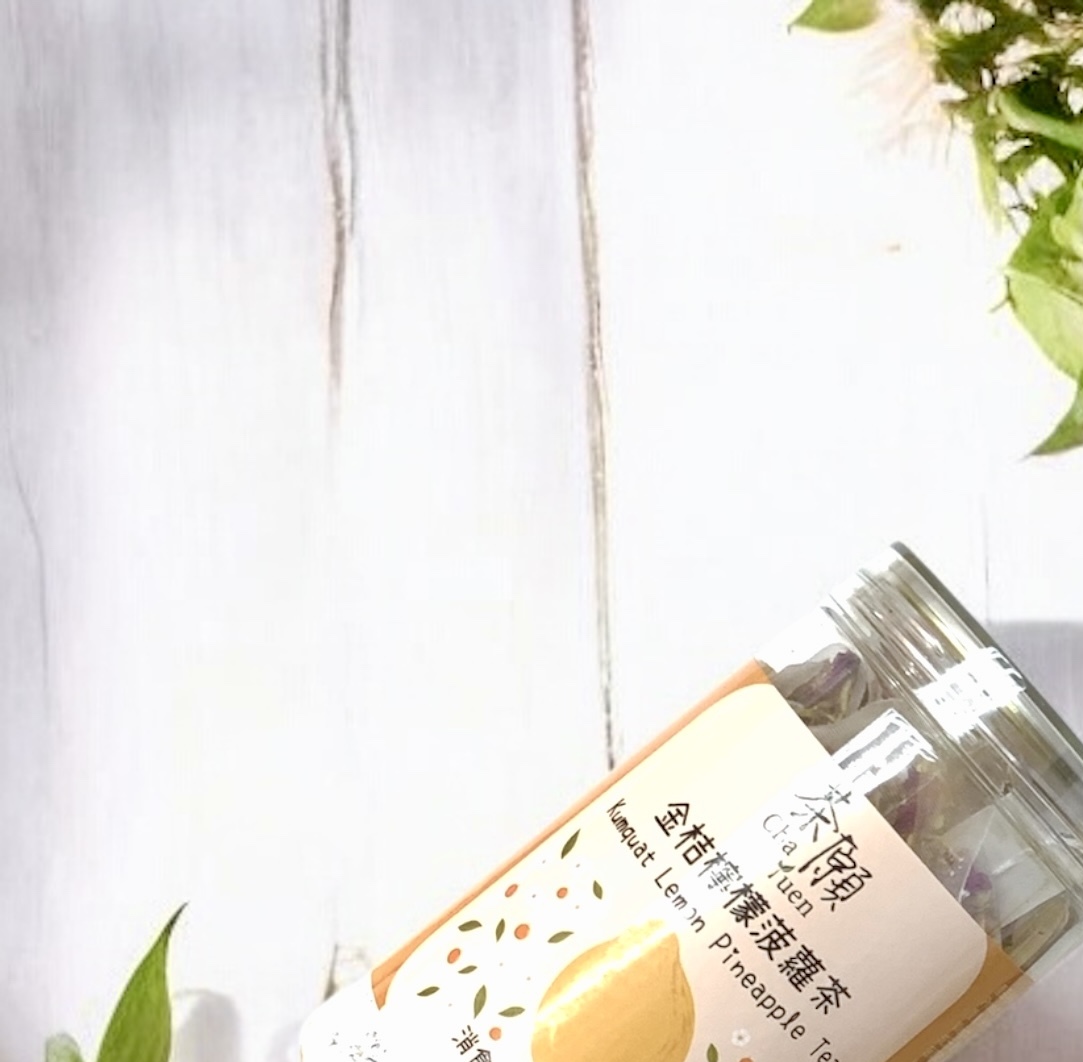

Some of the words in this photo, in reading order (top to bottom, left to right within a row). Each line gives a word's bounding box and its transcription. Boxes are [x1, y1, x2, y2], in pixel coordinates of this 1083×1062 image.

[606, 798, 656, 868] Kumquat
[708, 932, 806, 1040] Pineapple
[653, 802, 852, 1016] 金桔檸檬菠蘿茶
